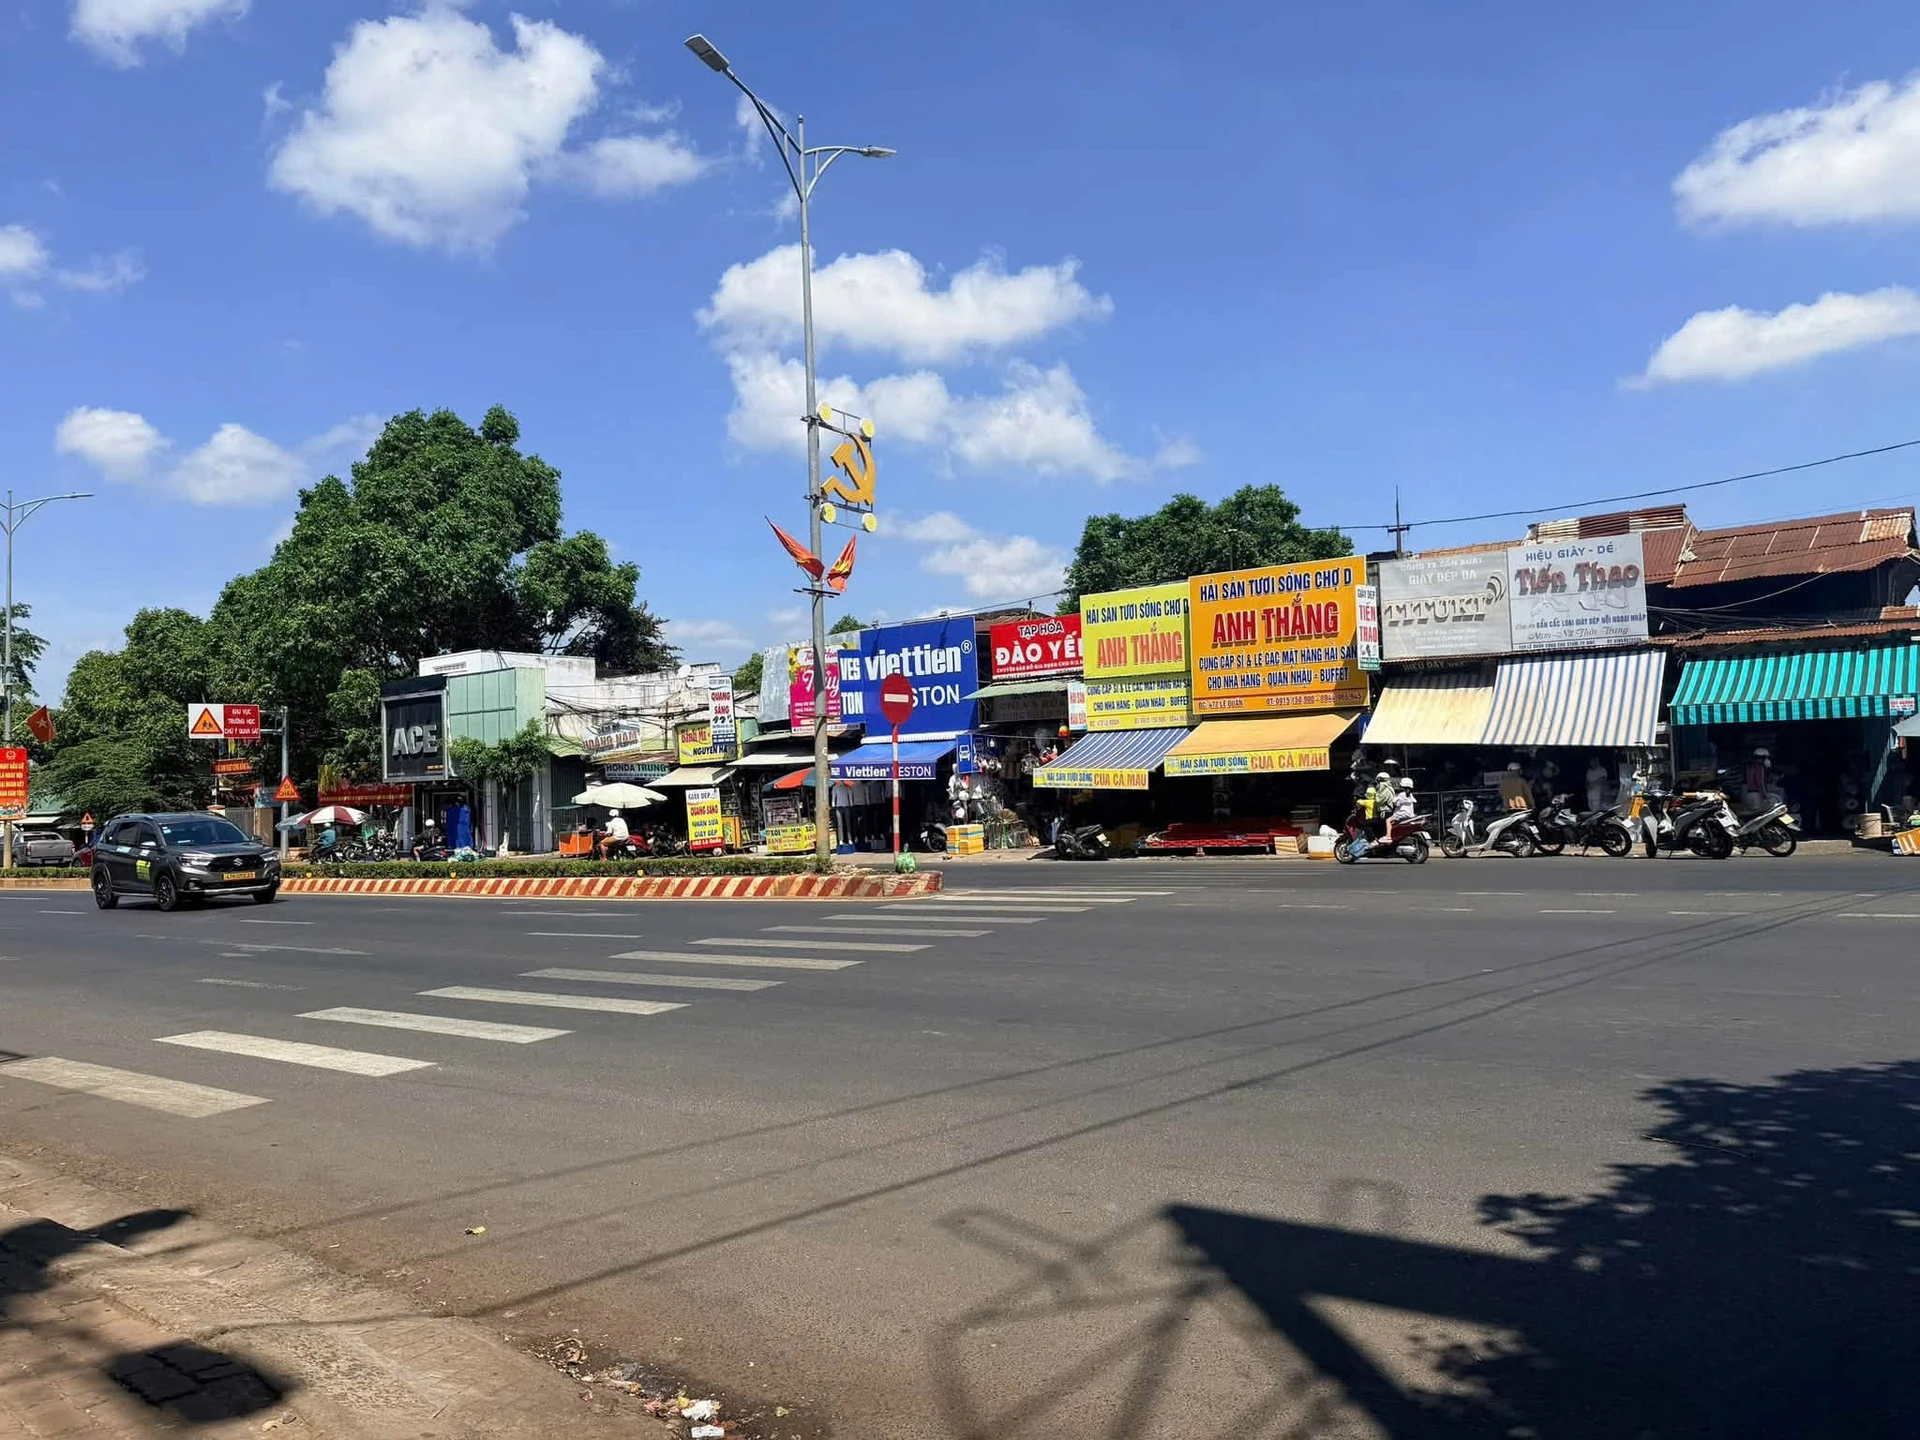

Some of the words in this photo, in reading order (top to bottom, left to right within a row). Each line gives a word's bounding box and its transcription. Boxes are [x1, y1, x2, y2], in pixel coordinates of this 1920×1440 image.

[1526, 549, 1552, 562] HIỆU
[1557, 546, 1586, 558] GIÀY
[1200, 580, 1219, 602] HẢI
[1222, 576, 1246, 600] SẢN
[1248, 576, 1275, 595] TƯƠI
[1278, 568, 1311, 593] SỐNG
[1314, 567, 1341, 591] CHỢ
[1086, 603, 1099, 625] HẢI
[1101, 602, 1117, 623] SẢN
[1119, 603, 1138, 621] TƯƠI
[1139, 597, 1162, 619] SỐNG
[1164, 598, 1181, 619] CHỢ
[1212, 610, 1257, 648] ANH
[1261, 592, 1339, 643] THẮNG
[1019, 625, 1038, 640] TẠP
[996, 641, 1042, 666] ĐÀO
[1097, 637, 1128, 668] ANH
[1130, 621, 1183, 665] THẮNG
[1199, 656, 1219, 670] CUNG
[1220, 651, 1235, 668] CẤP
[1300, 646, 1322, 662] HÀNG
[1324, 642, 1338, 660] HẢI
[840, 657, 861, 681] VES
[1207, 676, 1222, 689] CHO
[1223, 674, 1239, 688] NHÀ
[1240, 672, 1261, 687] HÀNG
[1267, 669, 1289, 687] QUÁN
[1320, 667, 1349, 682] BUFFET
[711, 691, 731, 702] QUANG
[840, 691, 864, 715] TON
[714, 703, 730, 715] SÁNG
[392, 725, 438, 757] ACE
[606, 764, 637, 773] HONDA
[637, 763, 666, 772] TRUNG
[891, 766, 931, 777] ESTON
[1251, 754, 1276, 769] CUA
[1278, 752, 1296, 768] CÀ
[1299, 751, 1328, 766] MAU
[1094, 773, 1111, 786] CUA
[1113, 771, 1125, 786] CÀ
[1127, 774, 1147, 786] MAU
